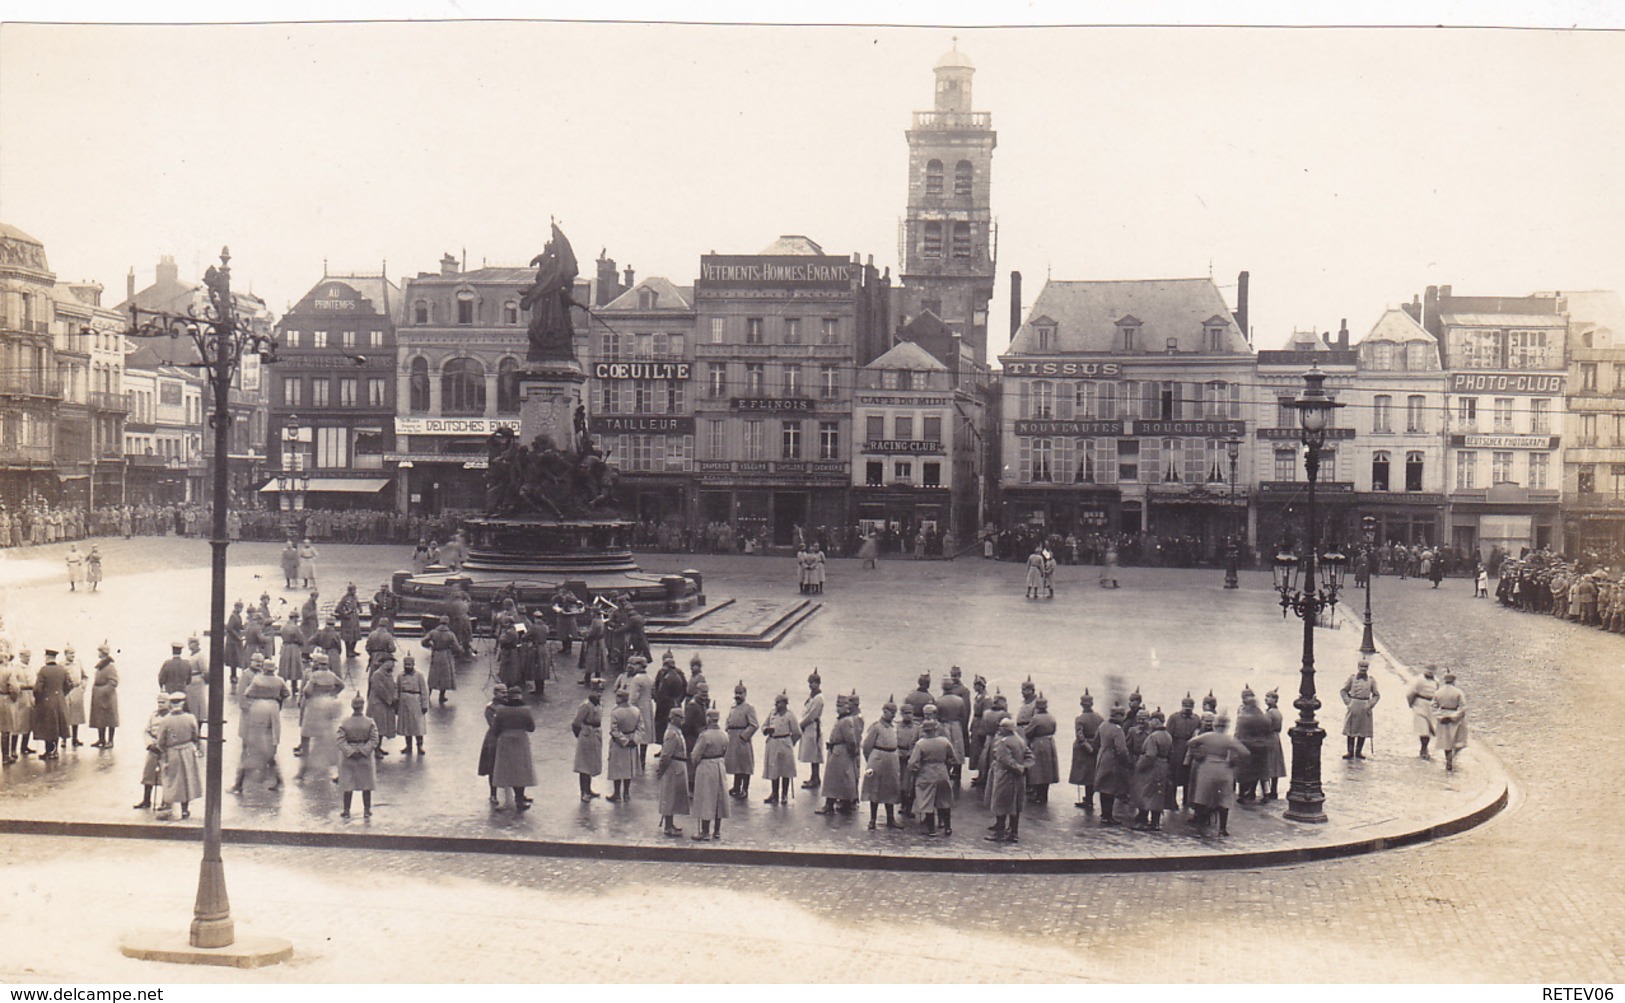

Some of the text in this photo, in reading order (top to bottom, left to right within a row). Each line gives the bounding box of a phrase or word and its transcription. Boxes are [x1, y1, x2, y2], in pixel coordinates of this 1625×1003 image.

[328, 288, 340, 298] AU
[315, 299, 355, 310] PRINTEMPS
[1008, 362, 1119, 375] TISSUS
[1455, 375, 1561, 392] PHOTO-CLUB
[750, 400, 807, 410] FLINOIS
[898, 397, 914, 406] DU
[917, 398, 946, 406] MIDI
[425, 420, 484, 432] DEUTSCHES
[606, 418, 677, 430] TAILLEUR
[1143, 423, 1236, 433] BOUCHERIE
[1266, 429, 1346, 438] COMESLES
